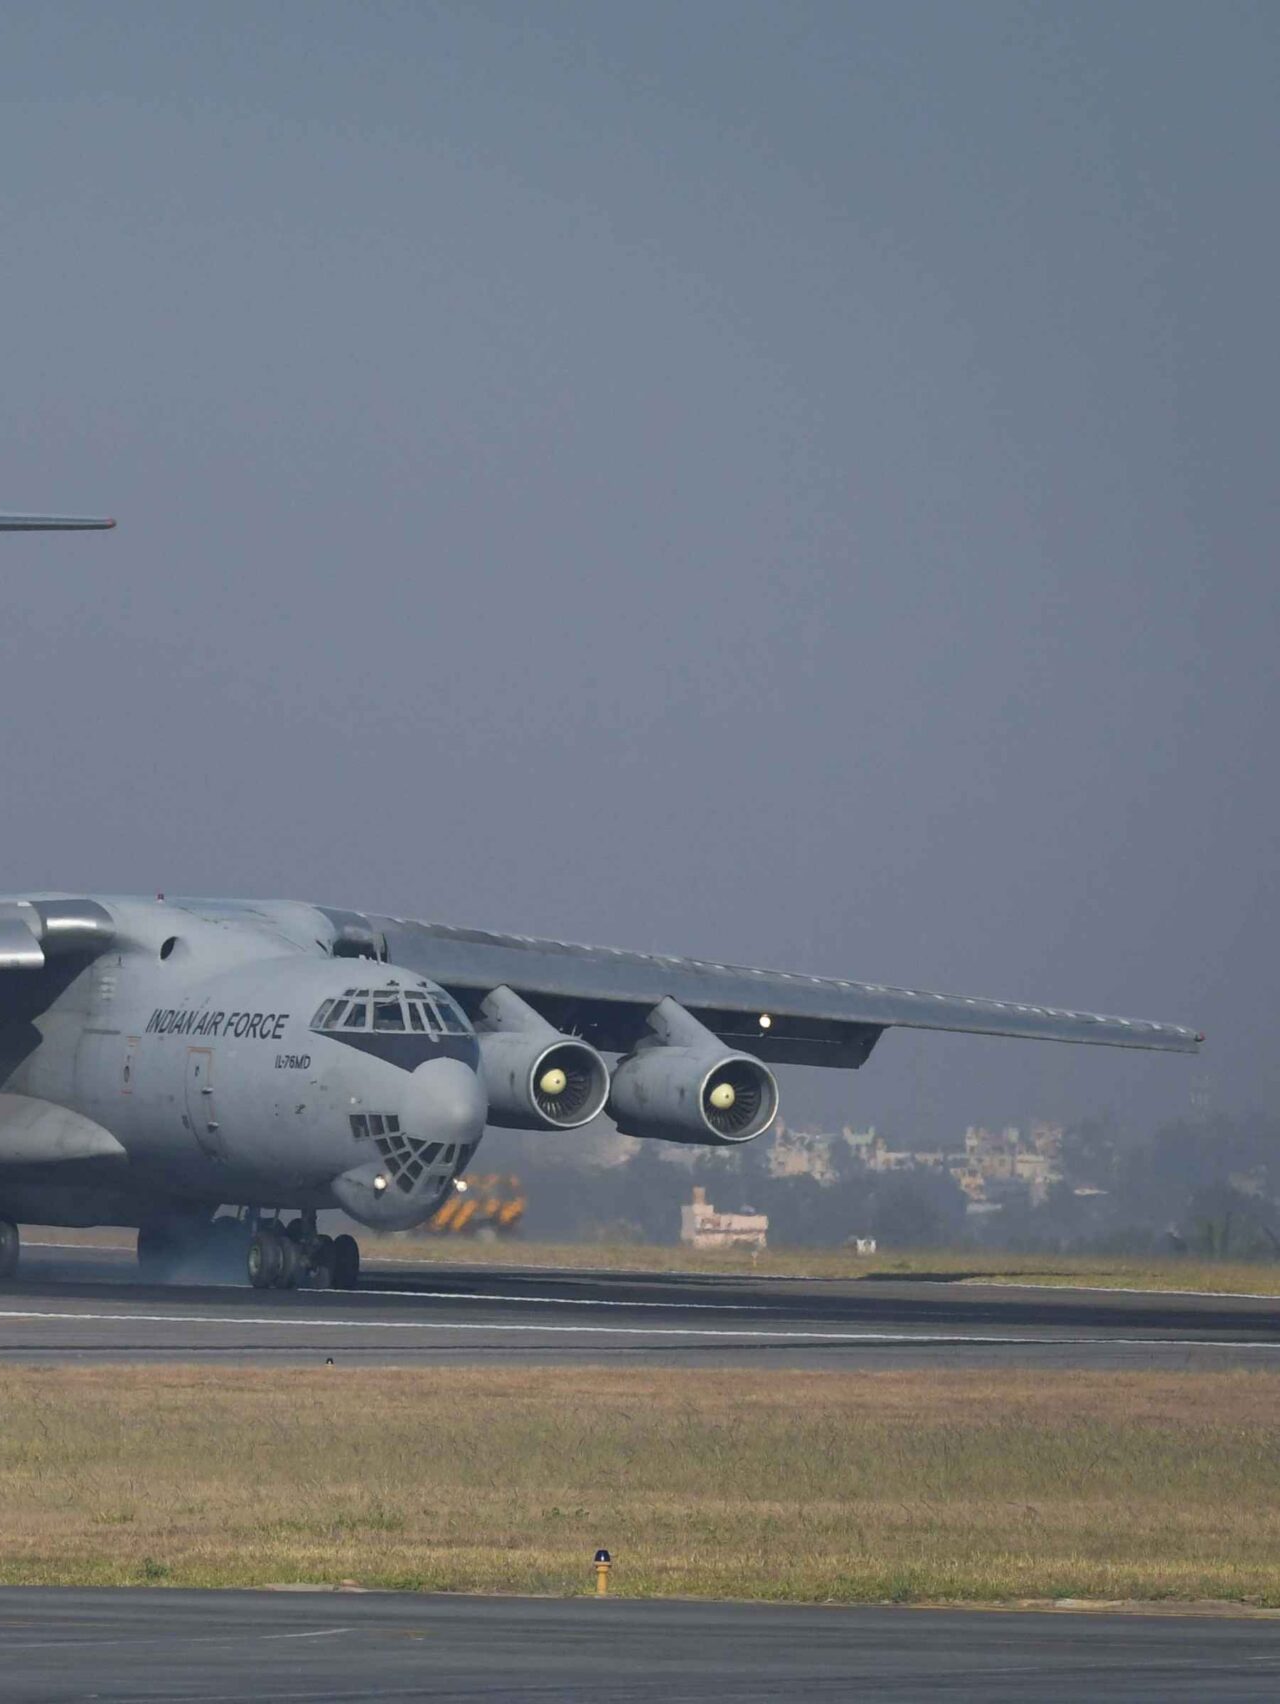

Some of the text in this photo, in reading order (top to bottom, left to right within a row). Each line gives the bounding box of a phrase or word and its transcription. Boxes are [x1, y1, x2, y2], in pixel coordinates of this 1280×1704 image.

[145, 1008, 290, 1040] INDIAN AIR FORCE
[274, 1053, 312, 1070] IL-76MD
